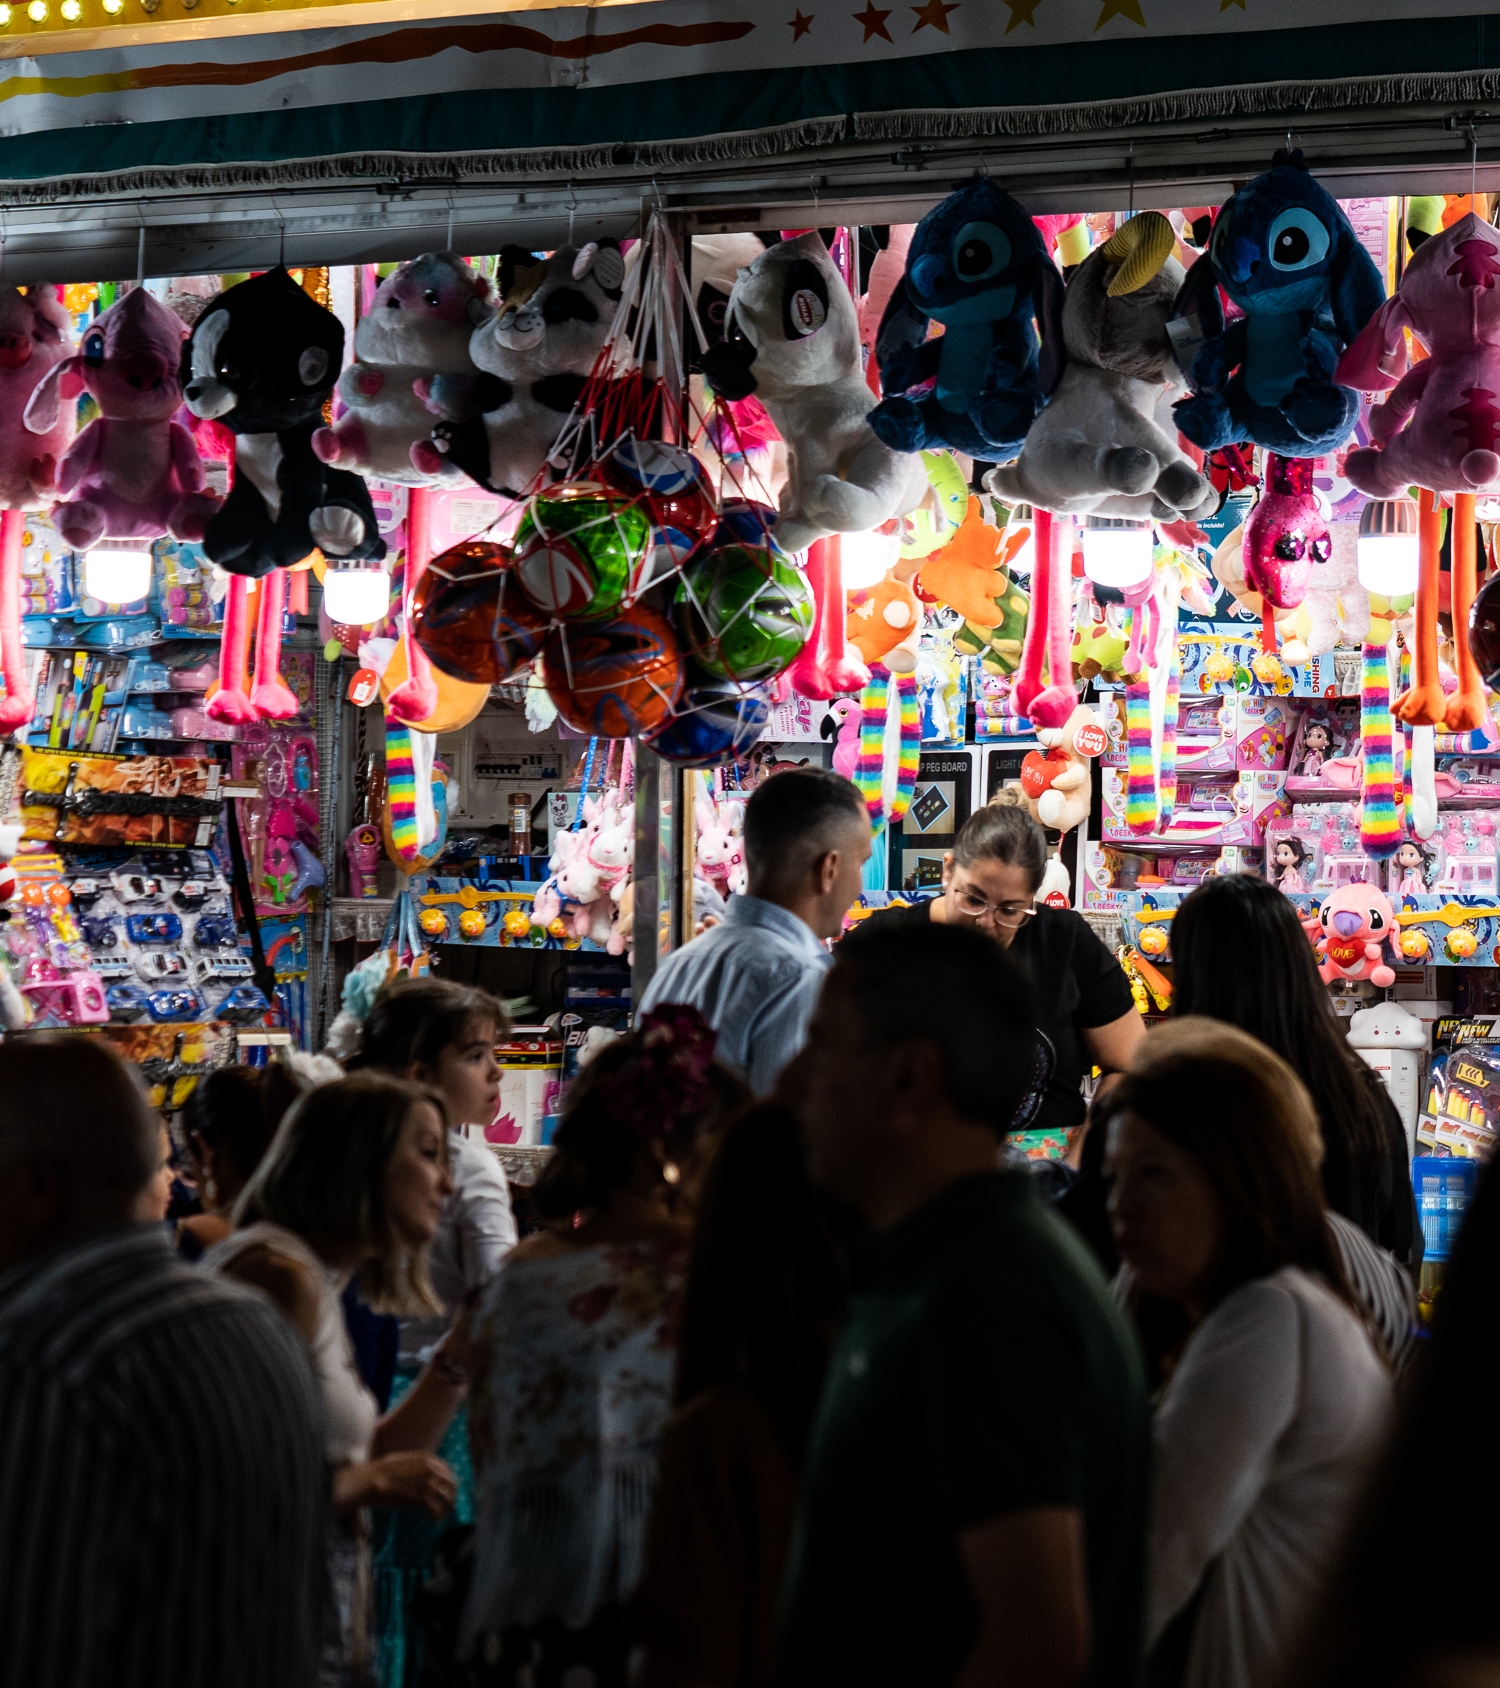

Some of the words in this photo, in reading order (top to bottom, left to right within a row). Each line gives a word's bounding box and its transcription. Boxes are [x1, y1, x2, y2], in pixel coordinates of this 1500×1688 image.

[1084, 732, 1104, 742] LOVE
[926, 762, 941, 772] PEG
[942, 762, 968, 772] BOARD
[996, 760, 1017, 770] LIGHT
[1331, 946, 1356, 959] LOVE
[1456, 1025, 1490, 1044] NEW
